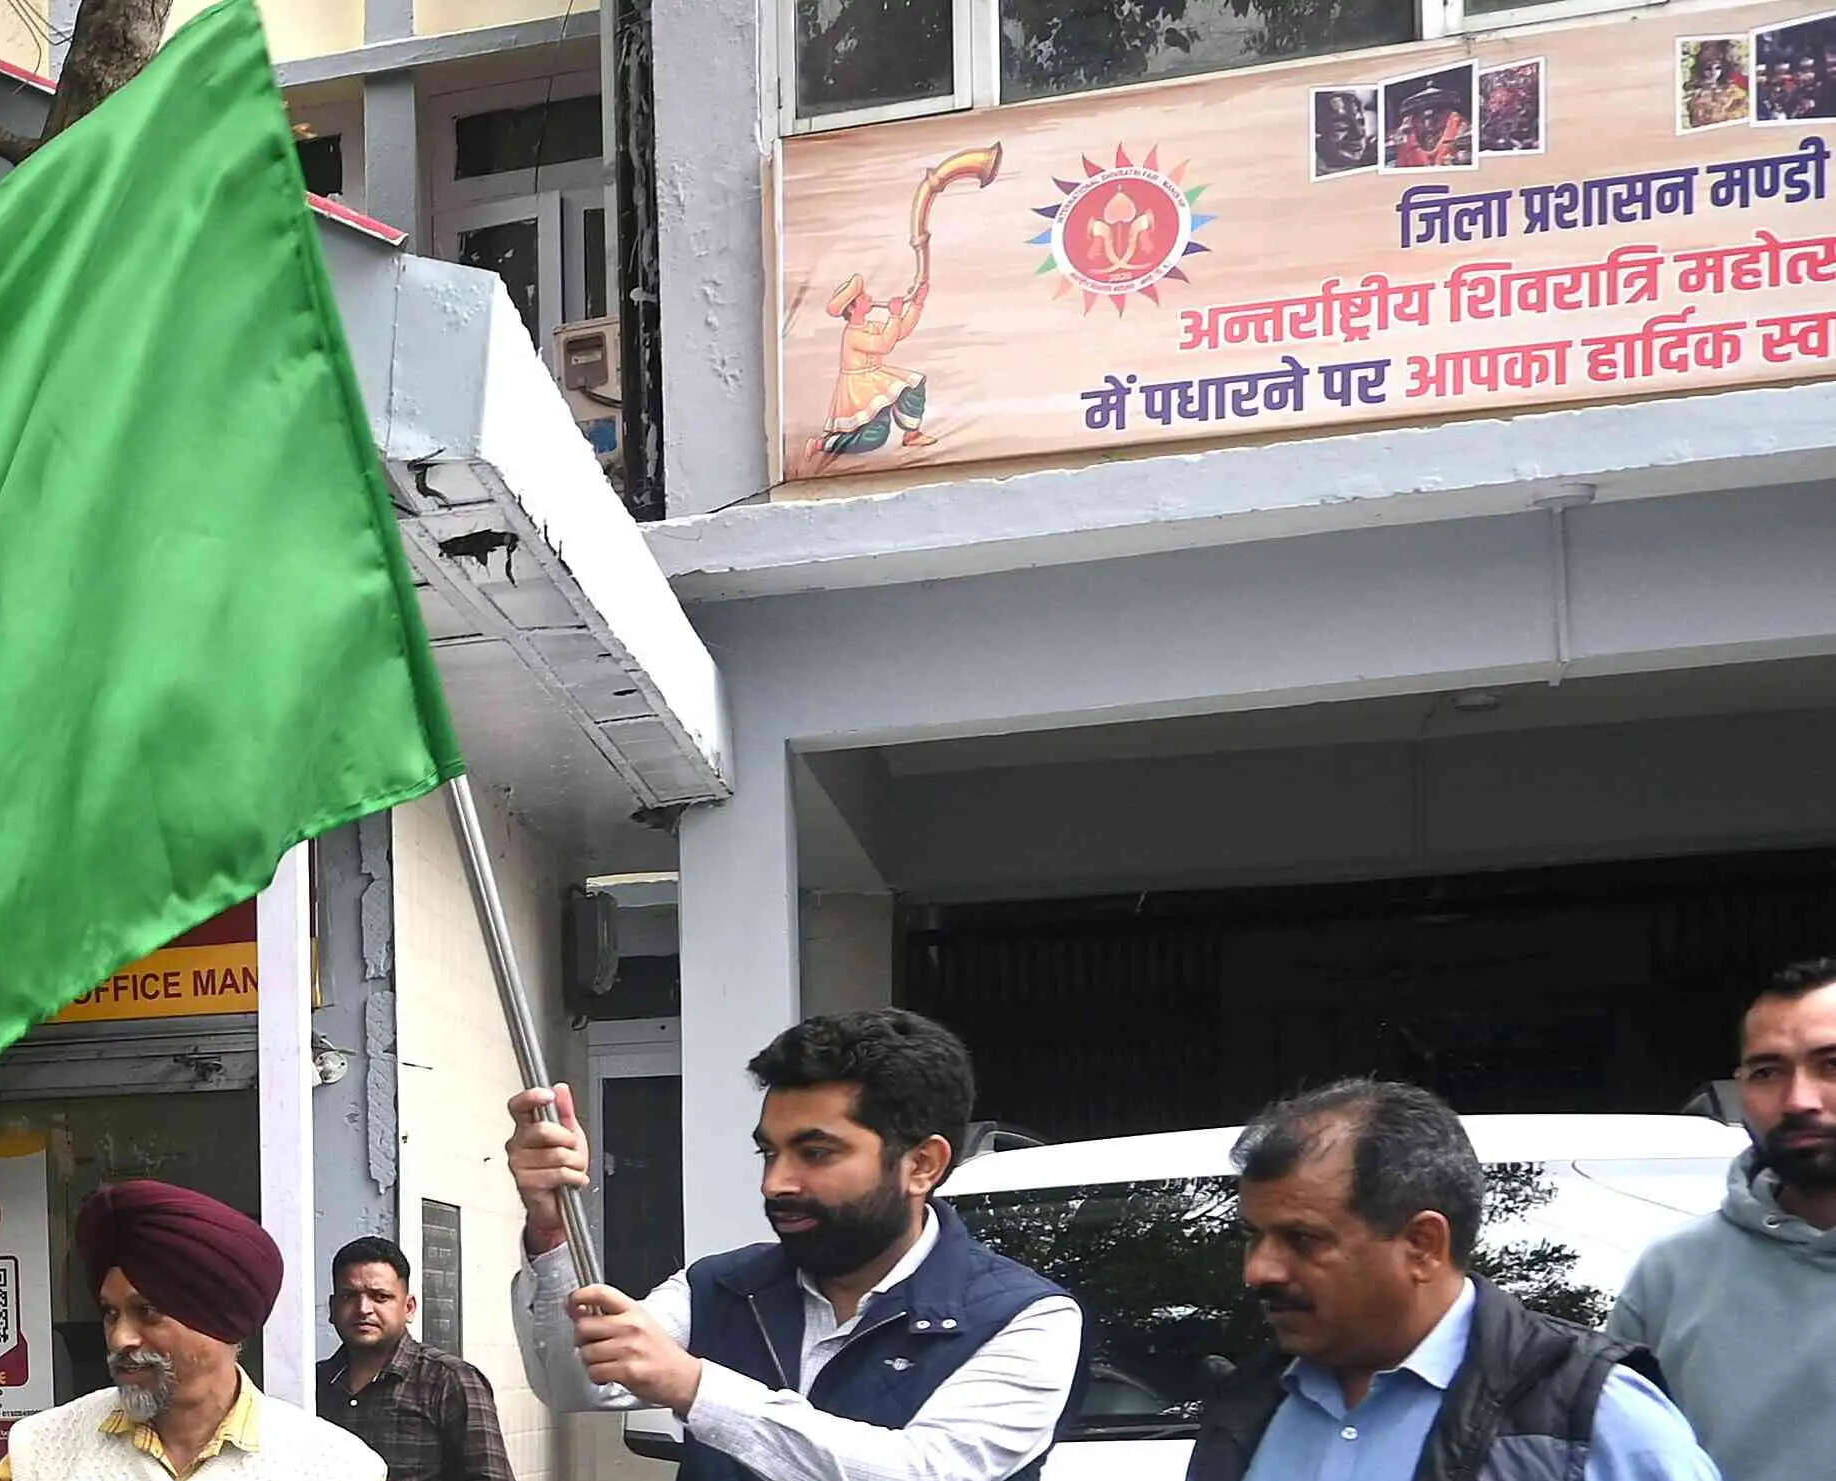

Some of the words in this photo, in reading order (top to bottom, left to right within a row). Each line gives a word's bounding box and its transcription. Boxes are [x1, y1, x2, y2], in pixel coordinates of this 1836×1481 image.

[1395, 185, 1513, 248] जिला
[1520, 166, 1699, 235] प्रशासन
[1706, 136, 1831, 209] मण्डी
[1179, 274, 1436, 349] अन्तर्राष्ट्रीय
[1444, 244, 1665, 322] शिवरात्रि
[1673, 230, 1836, 295] महोत्स
[1080, 374, 1137, 430] में
[1139, 355, 1310, 426] पधारने
[1317, 358, 1391, 407] पर
[1405, 340, 1573, 398] आपका
[1581, 306, 1747, 383] हार्दिक
[1756, 310, 1836, 363] स्व
